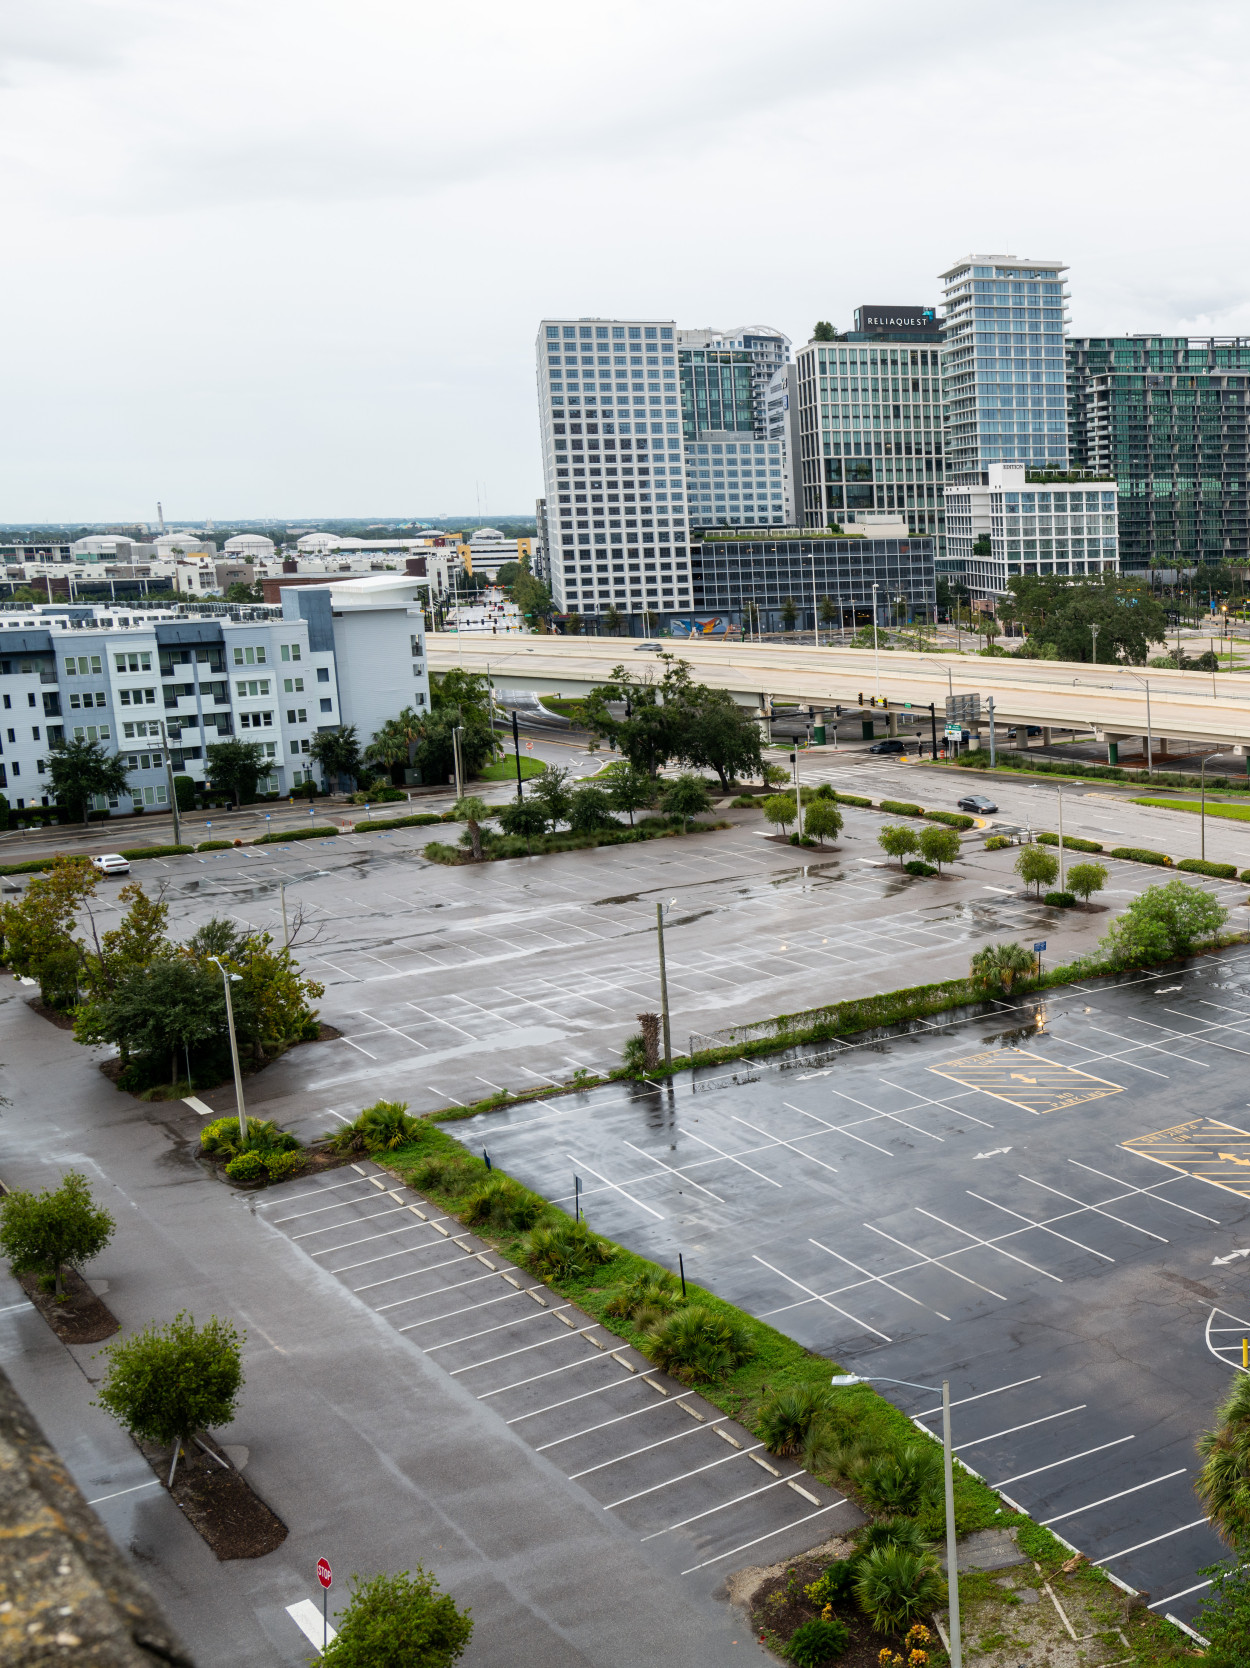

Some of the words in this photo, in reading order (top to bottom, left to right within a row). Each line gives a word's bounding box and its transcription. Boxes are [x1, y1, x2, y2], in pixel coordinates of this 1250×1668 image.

[867, 317, 927, 327] RELIAQUEST
[1050, 1090, 1107, 1108] PARKING
[1055, 1092, 1075, 1100] NO
[1140, 1124, 1199, 1144] PARKING
[1172, 1134, 1192, 1143] NO
[318, 1565, 331, 1581] STOP
